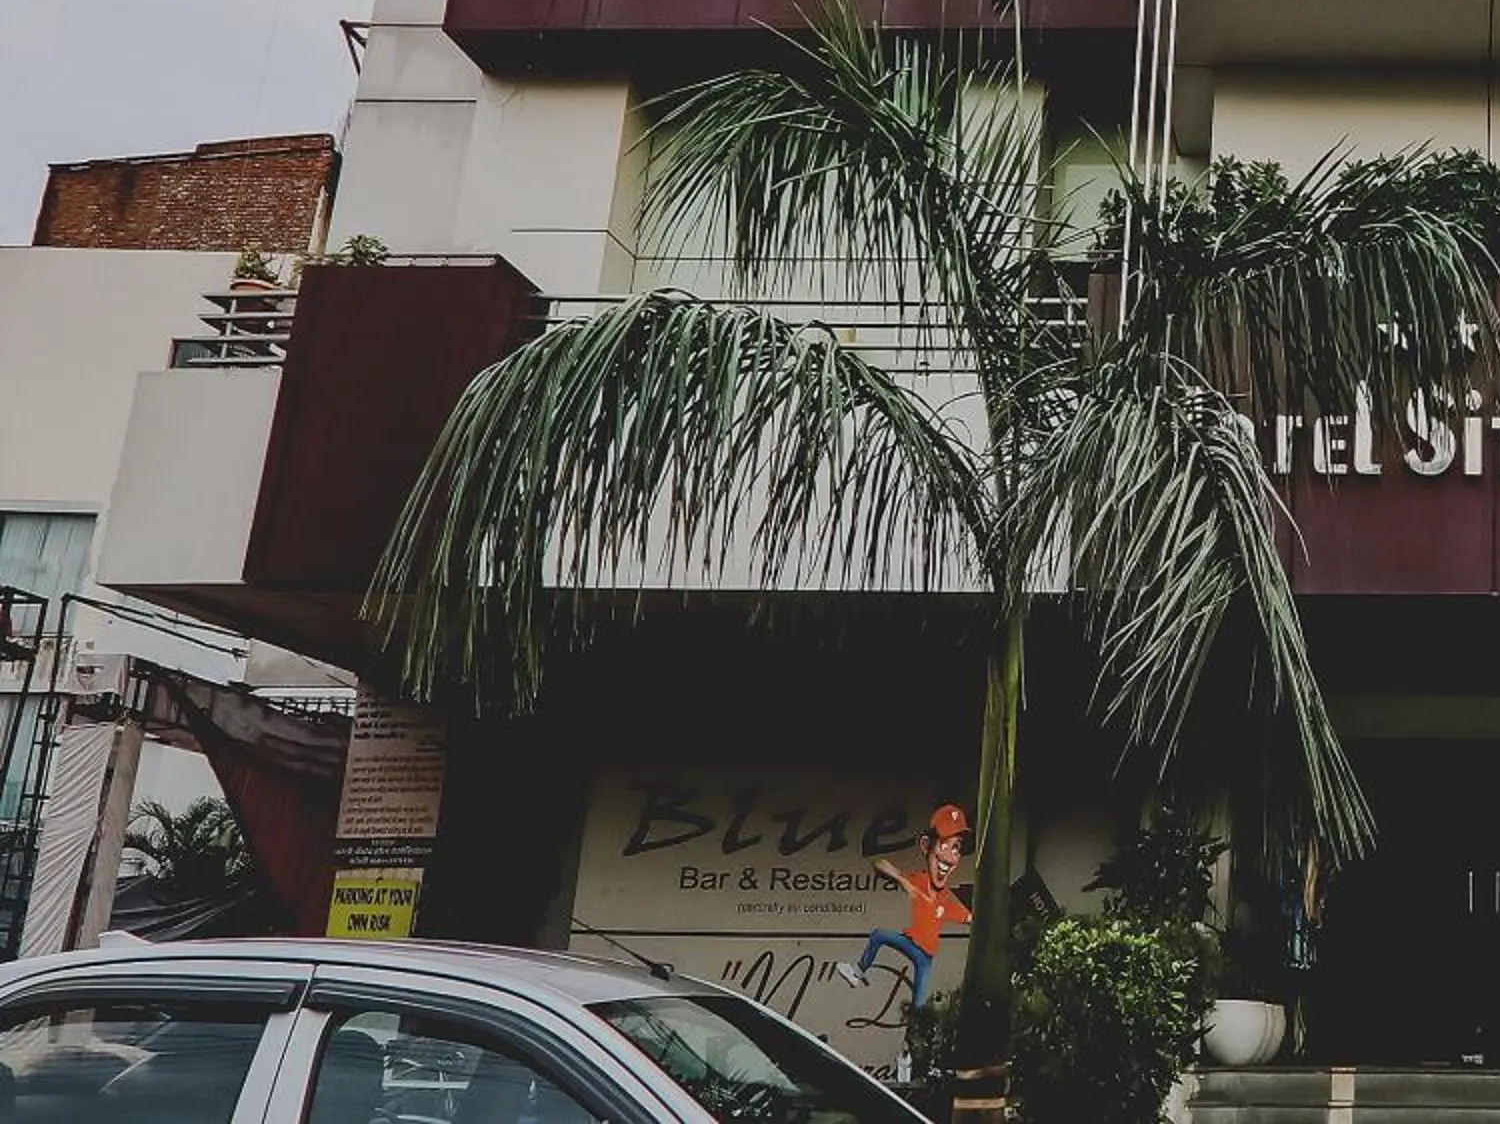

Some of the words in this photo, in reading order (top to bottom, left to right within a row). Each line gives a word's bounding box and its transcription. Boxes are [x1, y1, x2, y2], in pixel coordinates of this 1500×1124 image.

[679, 867, 730, 891] Bar
[739, 868, 758, 891] &
[770, 867, 908, 892] Restaura
[334, 887, 373, 905] PARKING
[374, 888, 388, 905] AT
[389, 888, 413, 906] YOUR
